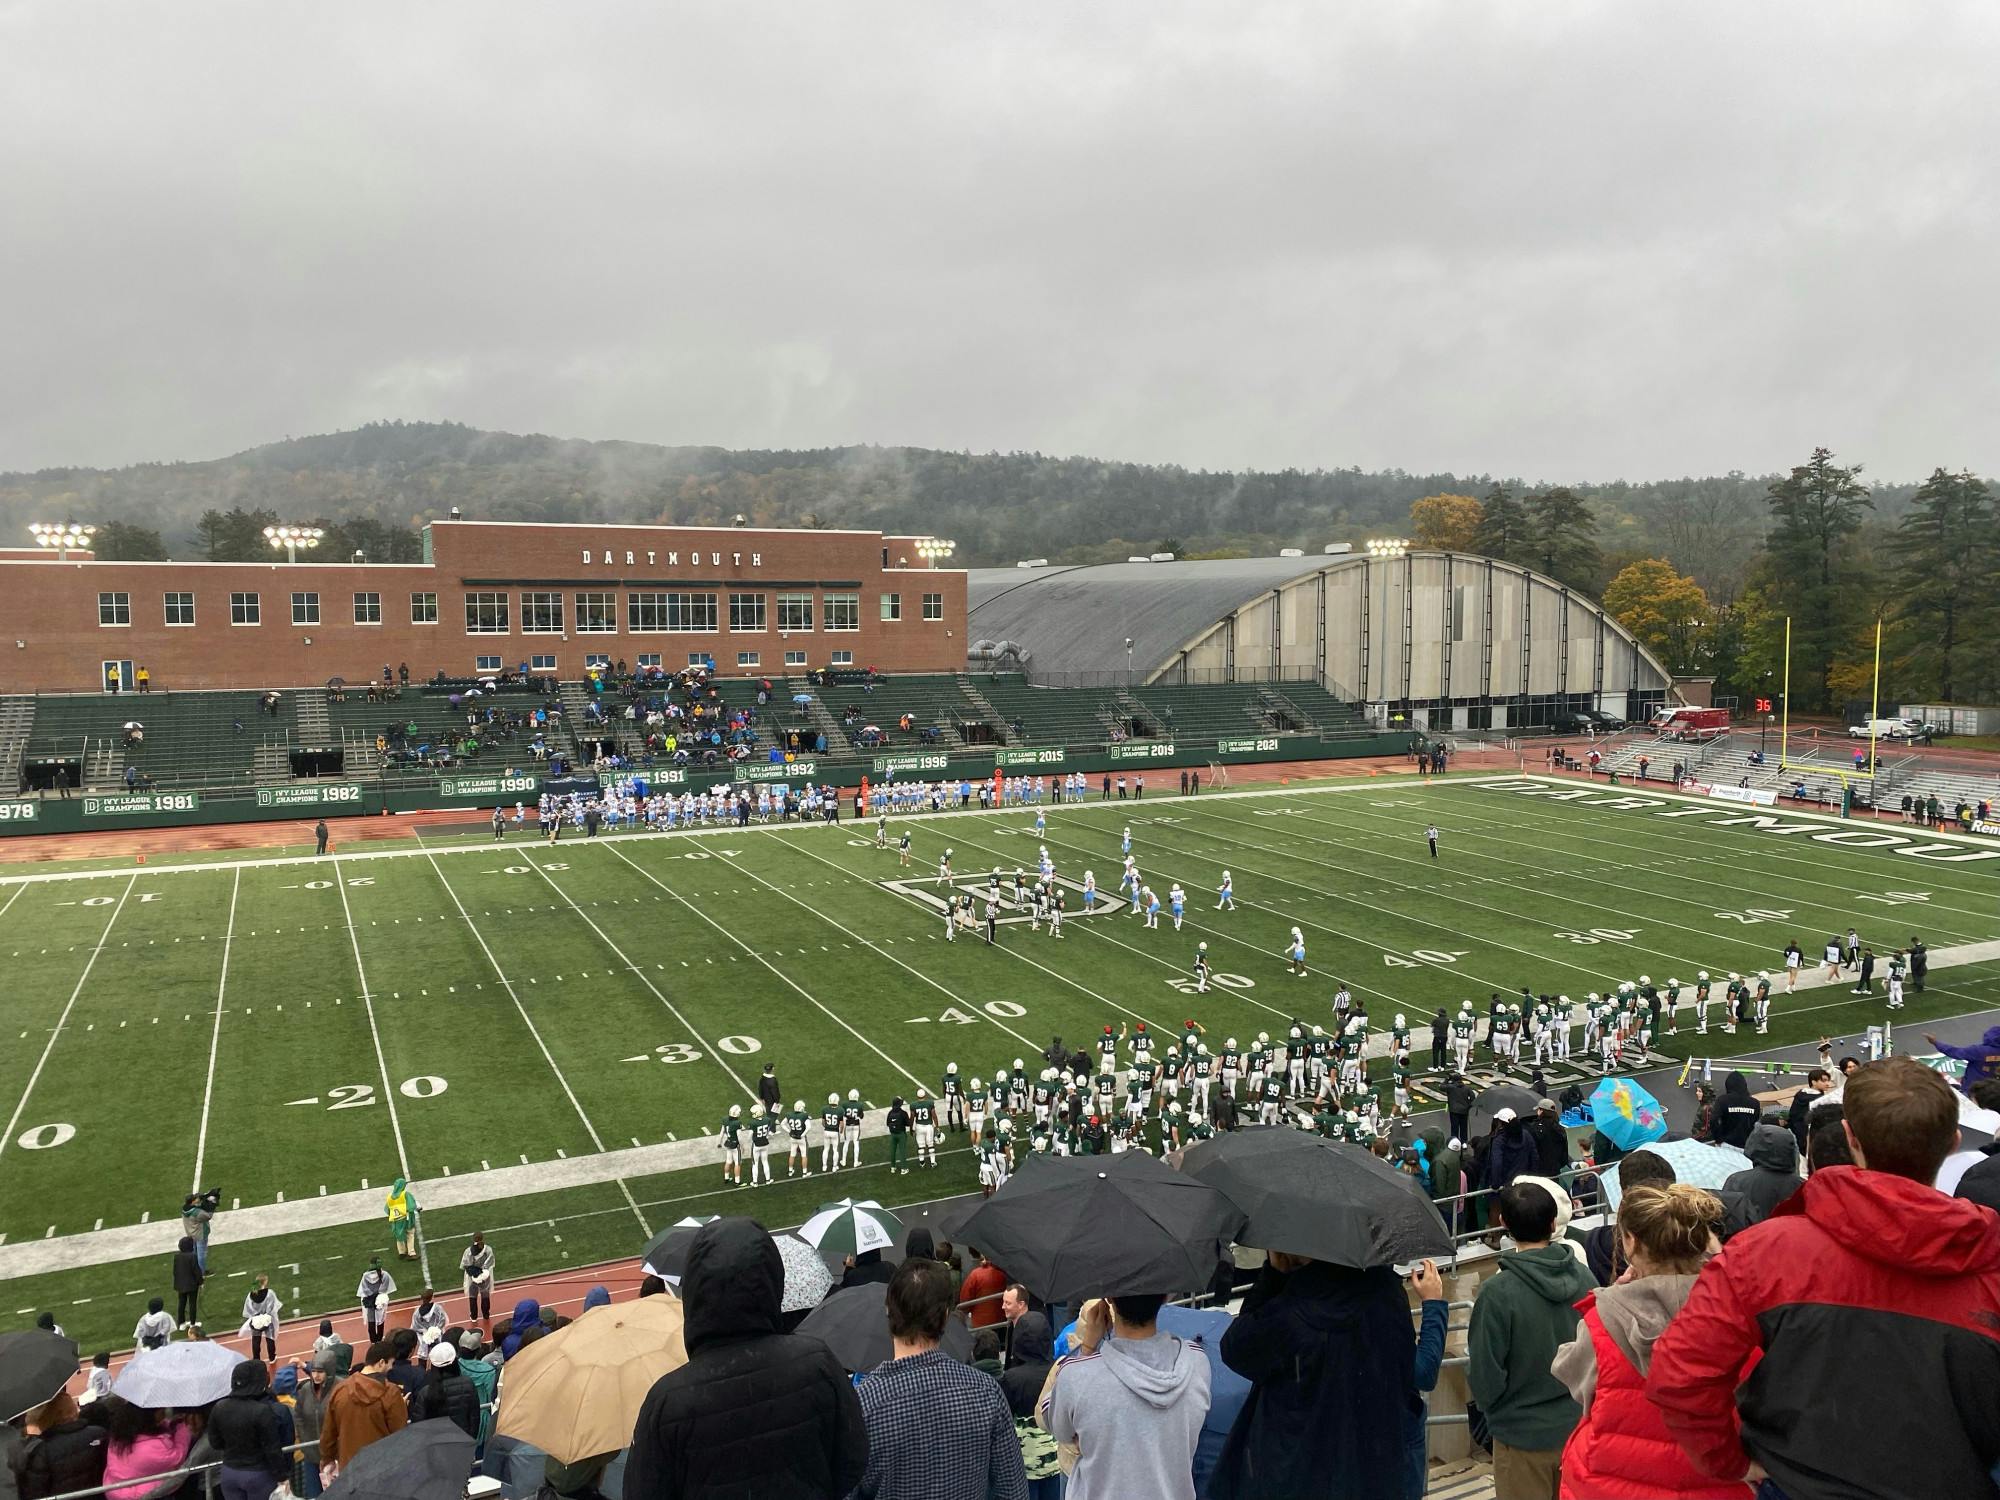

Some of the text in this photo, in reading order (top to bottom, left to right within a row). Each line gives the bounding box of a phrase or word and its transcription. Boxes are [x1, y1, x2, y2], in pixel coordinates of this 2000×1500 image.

[582, 550, 762, 566] DARTMOUTH
[1755, 698, 1771, 712] 36
[1150, 744, 1175, 757] 2019
[1256, 739, 1278, 751] 2021
[919, 756, 947, 769] 1996
[1038, 750, 1064, 763] 2015
[762, 764, 783, 772] LEAGUE
[785, 763, 815, 776] 1992
[613, 771, 651, 780] IVY LEAGUE
[653, 770, 685, 784] 1991
[457, 779, 497, 788] IVY LEAGUE
[499, 777, 535, 792] 1990
[275, 787, 319, 797] IVY LEAGUE
[322, 786, 359, 801] 1982
[103, 796, 150, 806] IVY LEAGUE
[154, 794, 194, 811] 1981
[1972, 819, 2000, 836] Ren
[1384, 949, 1457, 969] 40
[938, 1001, 1027, 1024] 40
[655, 1035, 762, 1064] 30
[1104, 1040, 1114, 1051] 12
[1137, 1038, 1147, 1049] 18
[1296, 1045, 1304, 1057] 11
[1225, 1055, 1237, 1067] 82
[1168, 1064, 1176, 1075] 8
[1197, 1062, 1209, 1073] 89
[1139, 1070, 1151, 1081] 66
[945, 1081, 955, 1093] 15
[1012, 1078, 1024, 1089] 20
[1101, 1082, 1111, 1094] 21
[326, 1076, 449, 1110] 20
[1267, 1083, 1280, 1097] 99
[972, 1099, 984, 1110] 37
[825, 1114, 838, 1126] 56
[915, 1108, 929, 1120] 73
[756, 1124, 769, 1138] 55
